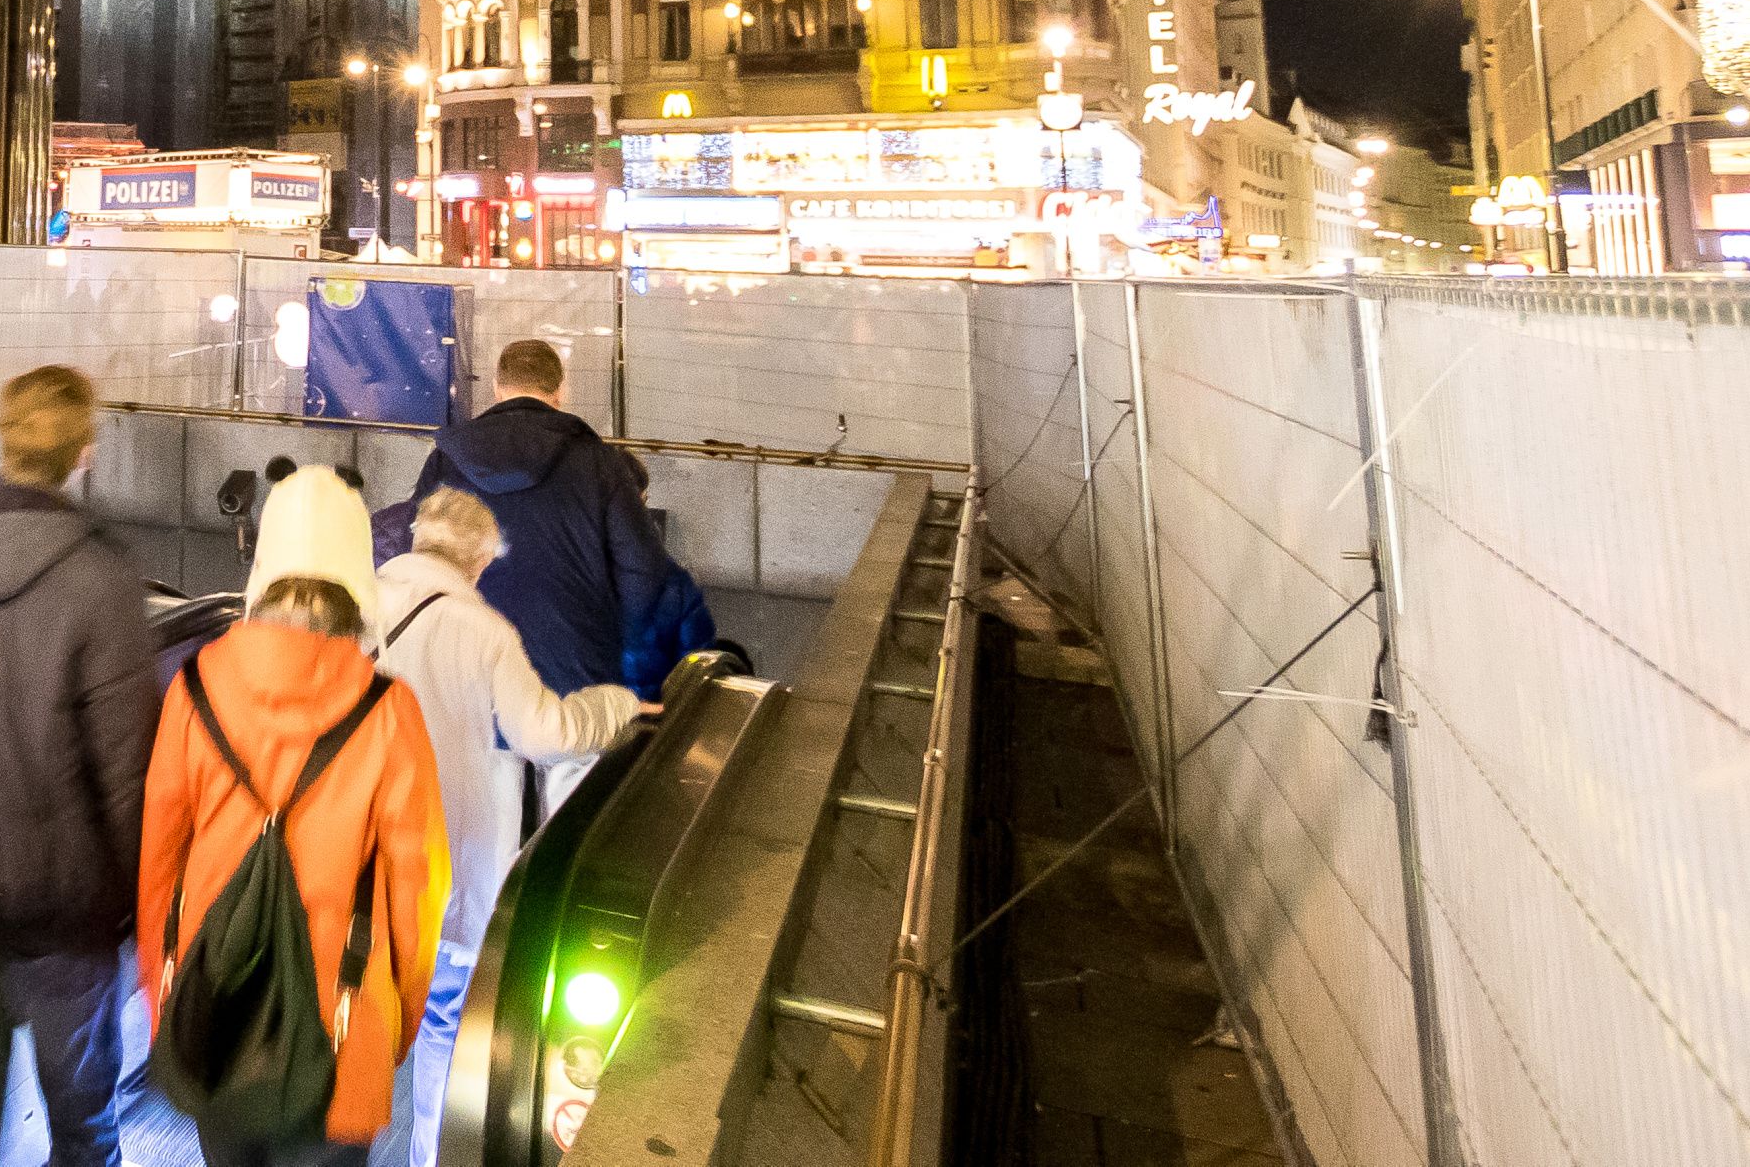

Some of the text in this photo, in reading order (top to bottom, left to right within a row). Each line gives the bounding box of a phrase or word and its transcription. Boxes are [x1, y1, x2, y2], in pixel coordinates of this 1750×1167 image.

[1143, 80, 1255, 136] Royal
[105, 179, 179, 204] POLIZEI
[253, 179, 309, 197] POLIZEI
